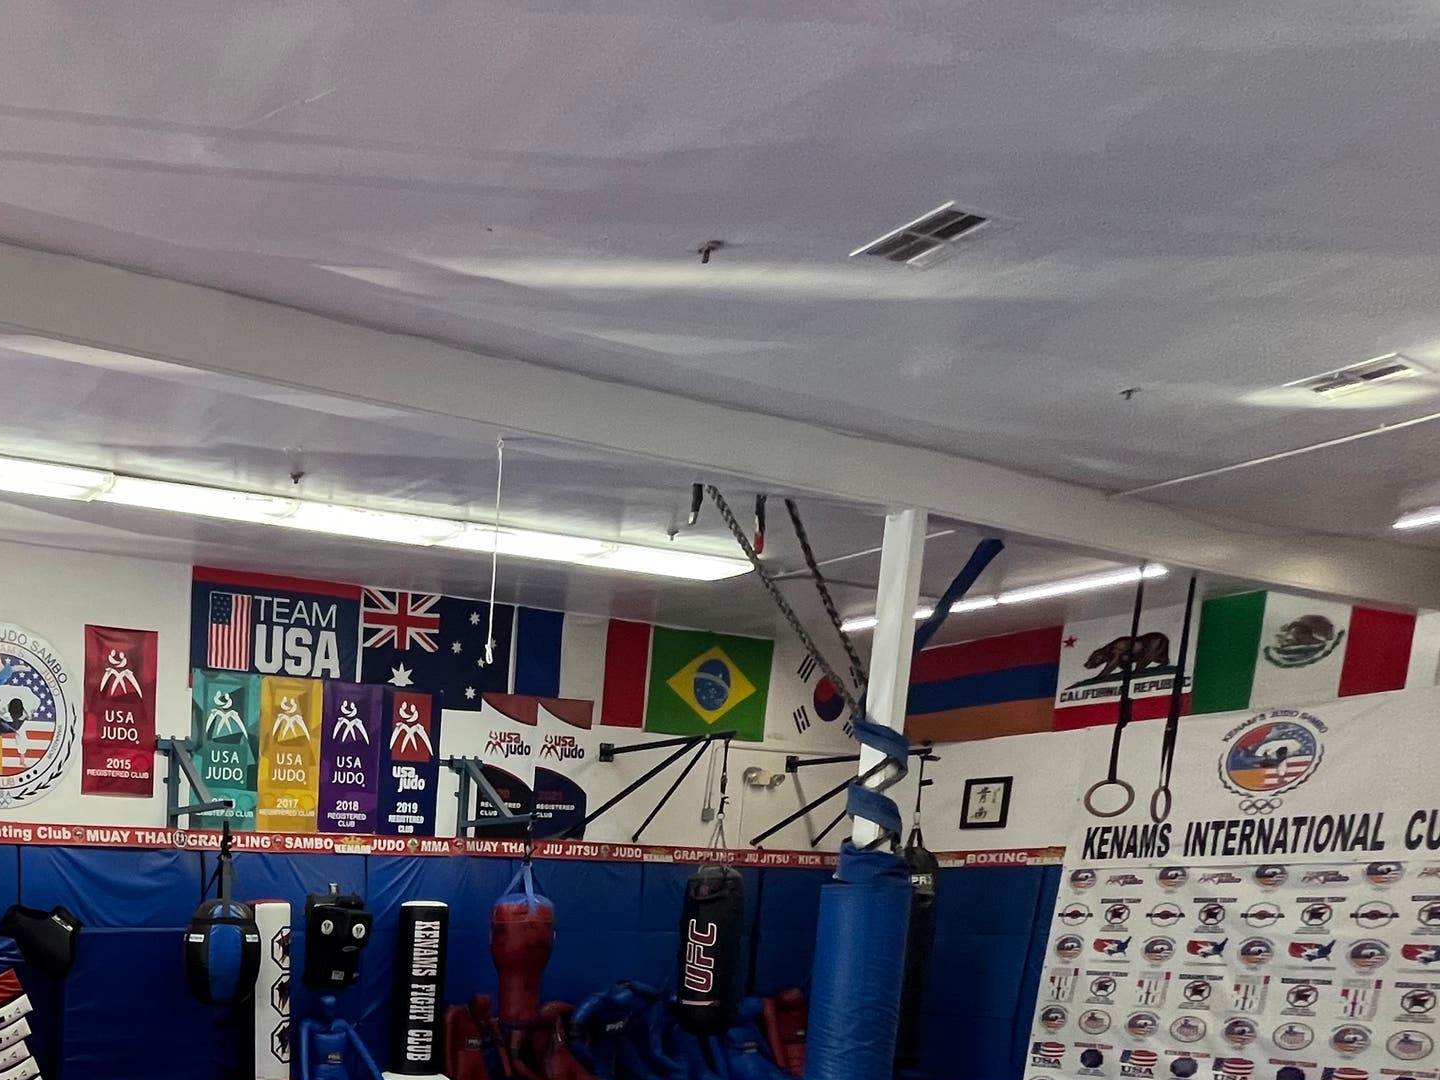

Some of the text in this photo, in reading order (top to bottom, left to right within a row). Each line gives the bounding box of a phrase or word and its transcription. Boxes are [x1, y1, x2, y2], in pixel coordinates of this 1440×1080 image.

[254, 595, 337, 629] TEAM
[254, 624, 340, 679] USA
[30, 640, 68, 684] SAMBO
[1134, 676, 1191, 693] REPUBC
[105, 709, 135, 724] USA
[211, 750, 240, 764] USA
[505, 743, 531, 758] judo
[559, 746, 585, 761] judo
[106, 758, 131, 770] 2015
[276, 753, 303, 766] USA
[336, 756, 362, 768] USA
[87, 768, 130, 778] REGISTERED
[397, 775, 426, 792] judo
[276, 798, 299, 809] 2017
[336, 800, 359, 812] 2018
[396, 802, 418, 814] 2019
[536, 803, 575, 811] REGISTERED
[235, 810, 254, 818] CLUB
[327, 812, 367, 821] REGISTERED
[338, 820, 356, 828] CLUB
[37, 826, 71, 840] Club
[86, 829, 131, 843] MUAY
[135, 831, 171, 845] THAI
[187, 835, 271, 850] GRAPLING
[285, 836, 333, 850] SAMBO
[1083, 823, 1172, 860] KENAMS
[1183, 812, 1385, 857] INTERNATIONAL
[371, 838, 406, 852] JUDO
[421, 841, 450, 852] MMA
[466, 841, 499, 853] MUAY
[543, 843, 562, 855] JIU
[565, 845, 598, 857] JITSU
[613, 847, 642, 858] JUDO
[674, 850, 735, 862] GRAPPLING
[745, 852, 759, 863] JIU
[760, 853, 790, 864] JITSU
[965, 852, 1028, 865] BOXING
[684, 918, 718, 993] UFC
[406, 920, 441, 1062] KENAMS FIGHT CLUB
